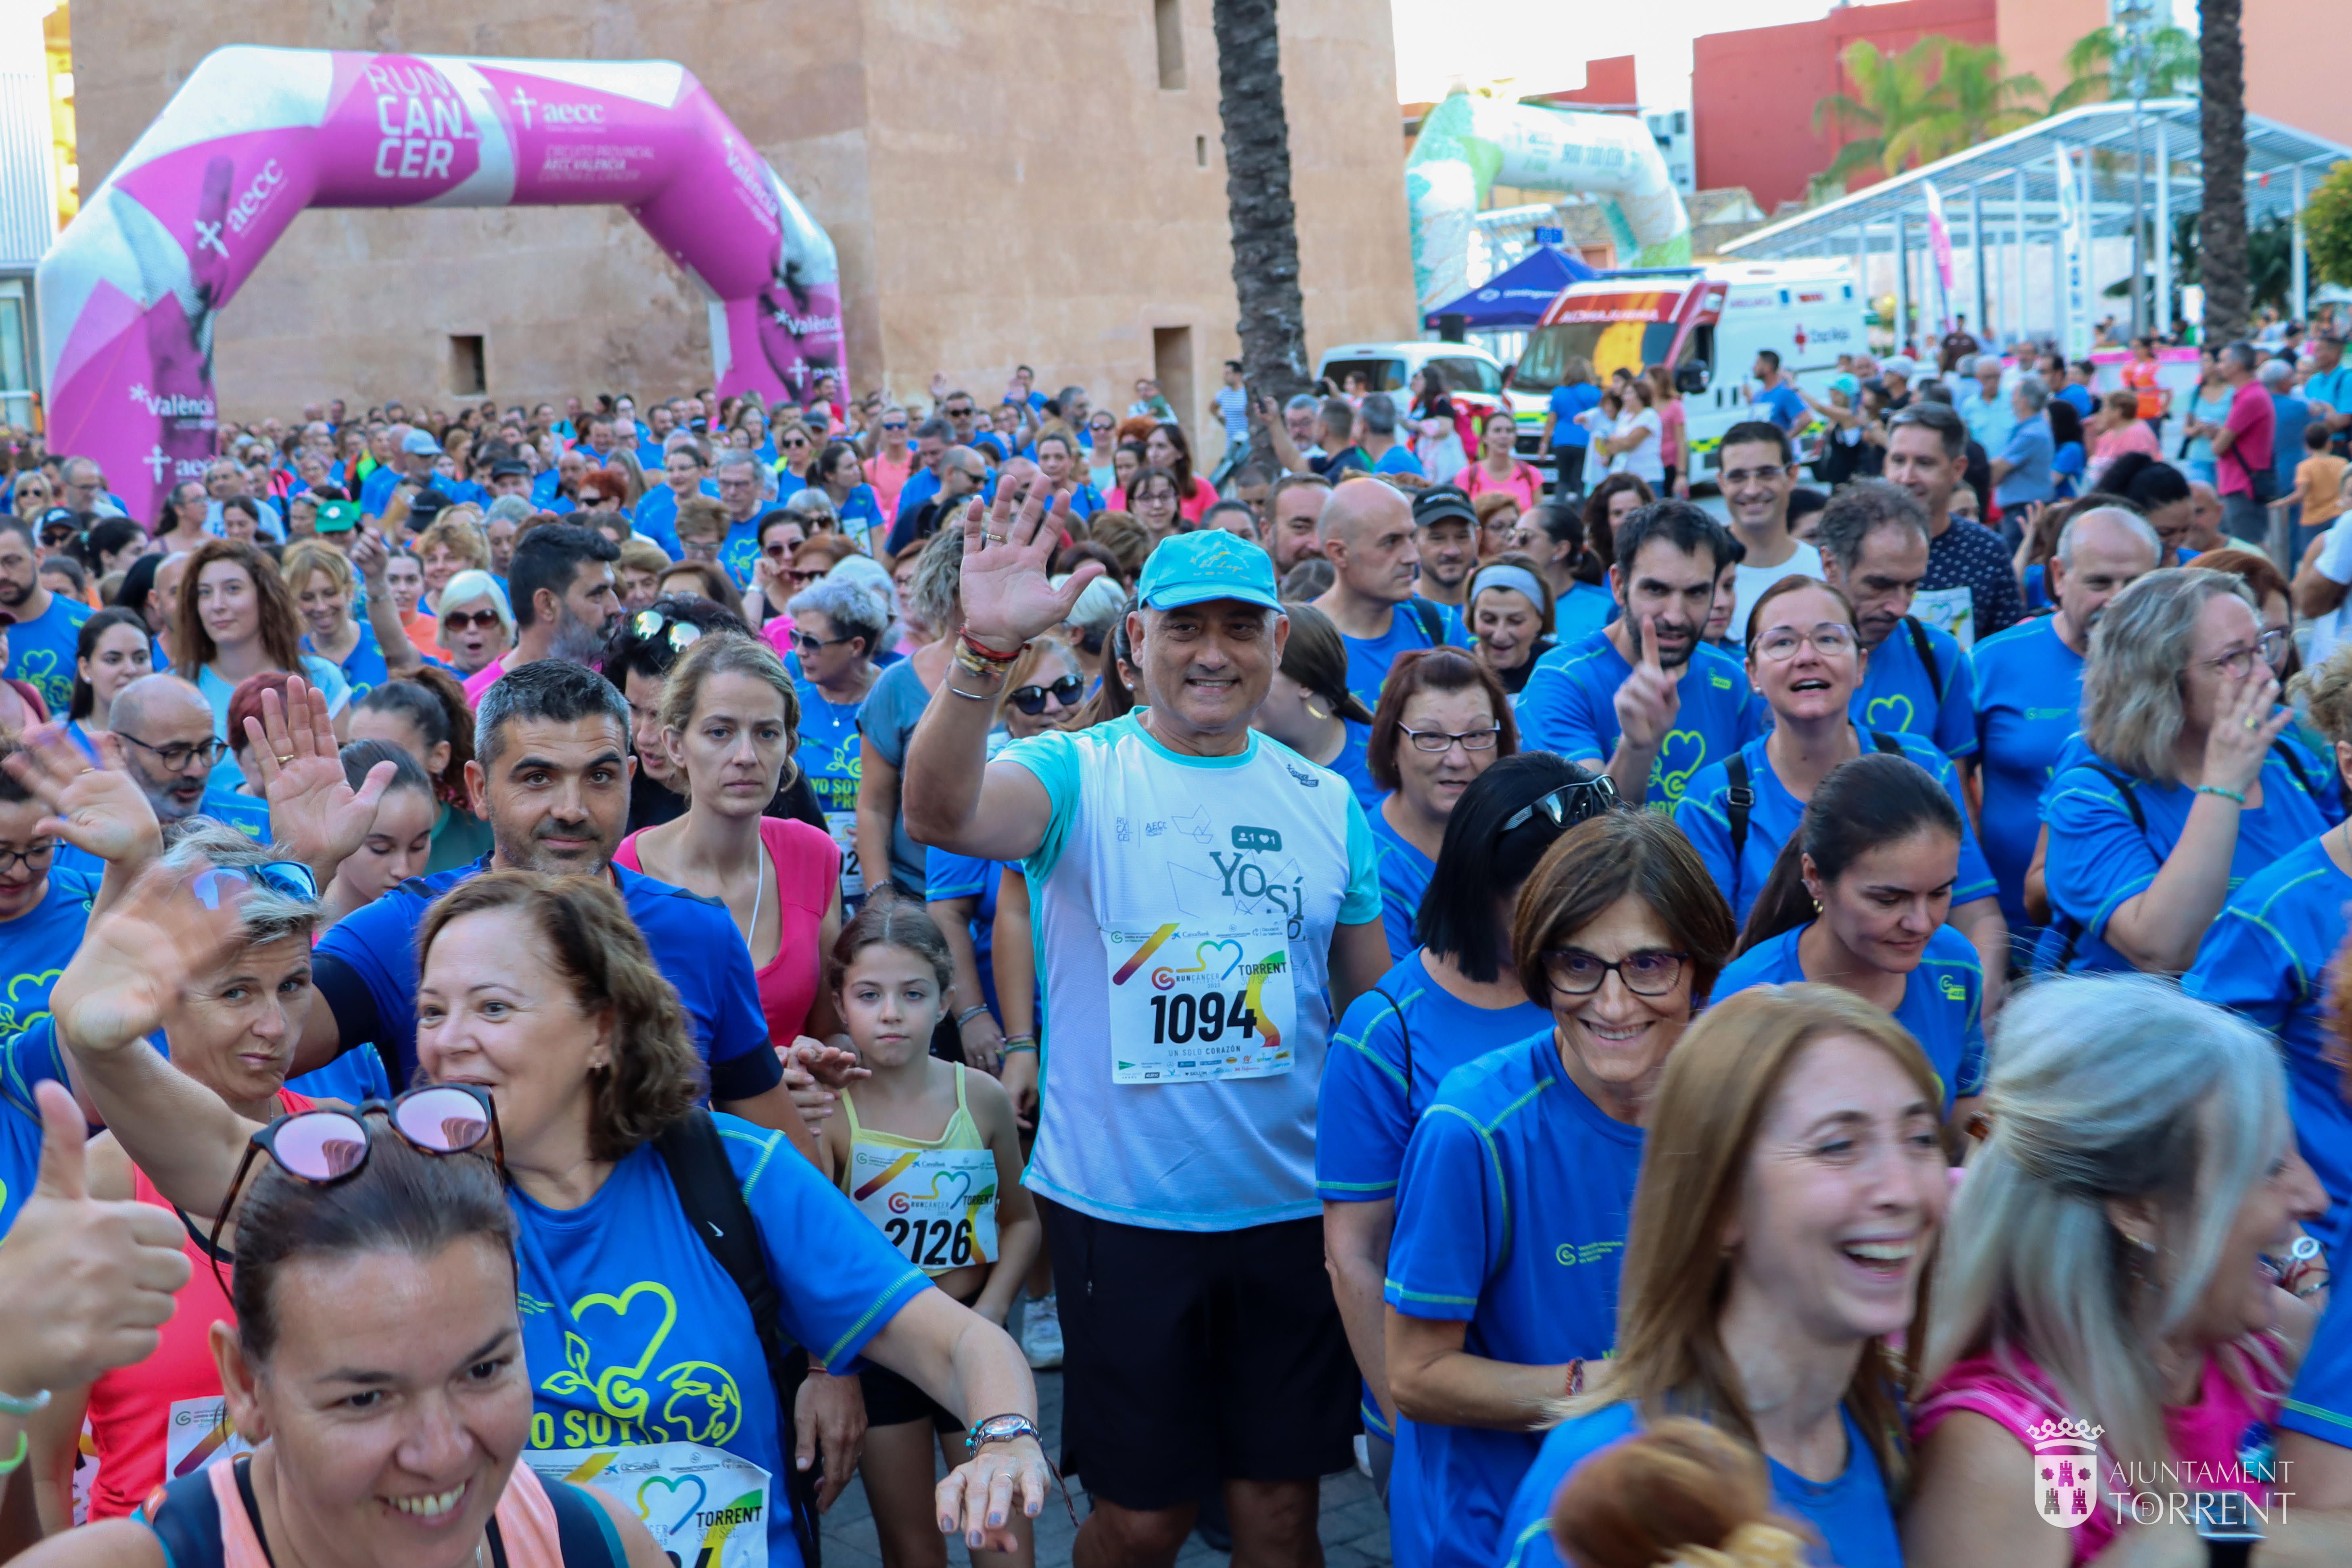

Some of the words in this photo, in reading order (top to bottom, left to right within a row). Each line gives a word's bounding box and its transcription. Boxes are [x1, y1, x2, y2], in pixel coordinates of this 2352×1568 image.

[362, 63, 450, 96] RUN
[543, 103, 604, 124] aecc
[375, 138, 454, 178] CER
[226, 158, 284, 233] aecc
[1249, 833, 1255, 842] 1
[1270, 836, 1276, 845] 1
[1238, 962, 1287, 976] TORRENT
[1241, 977, 1251, 985] 30
[1151, 990, 1257, 1044] 1094
[1205, 1045, 1241, 1055] CORAZÓN
[963, 1194, 994, 1207] TORRENT
[885, 1218, 972, 1266] 2126
[531, 1412, 554, 1449] O
[696, 1505, 762, 1528] TORRENT
